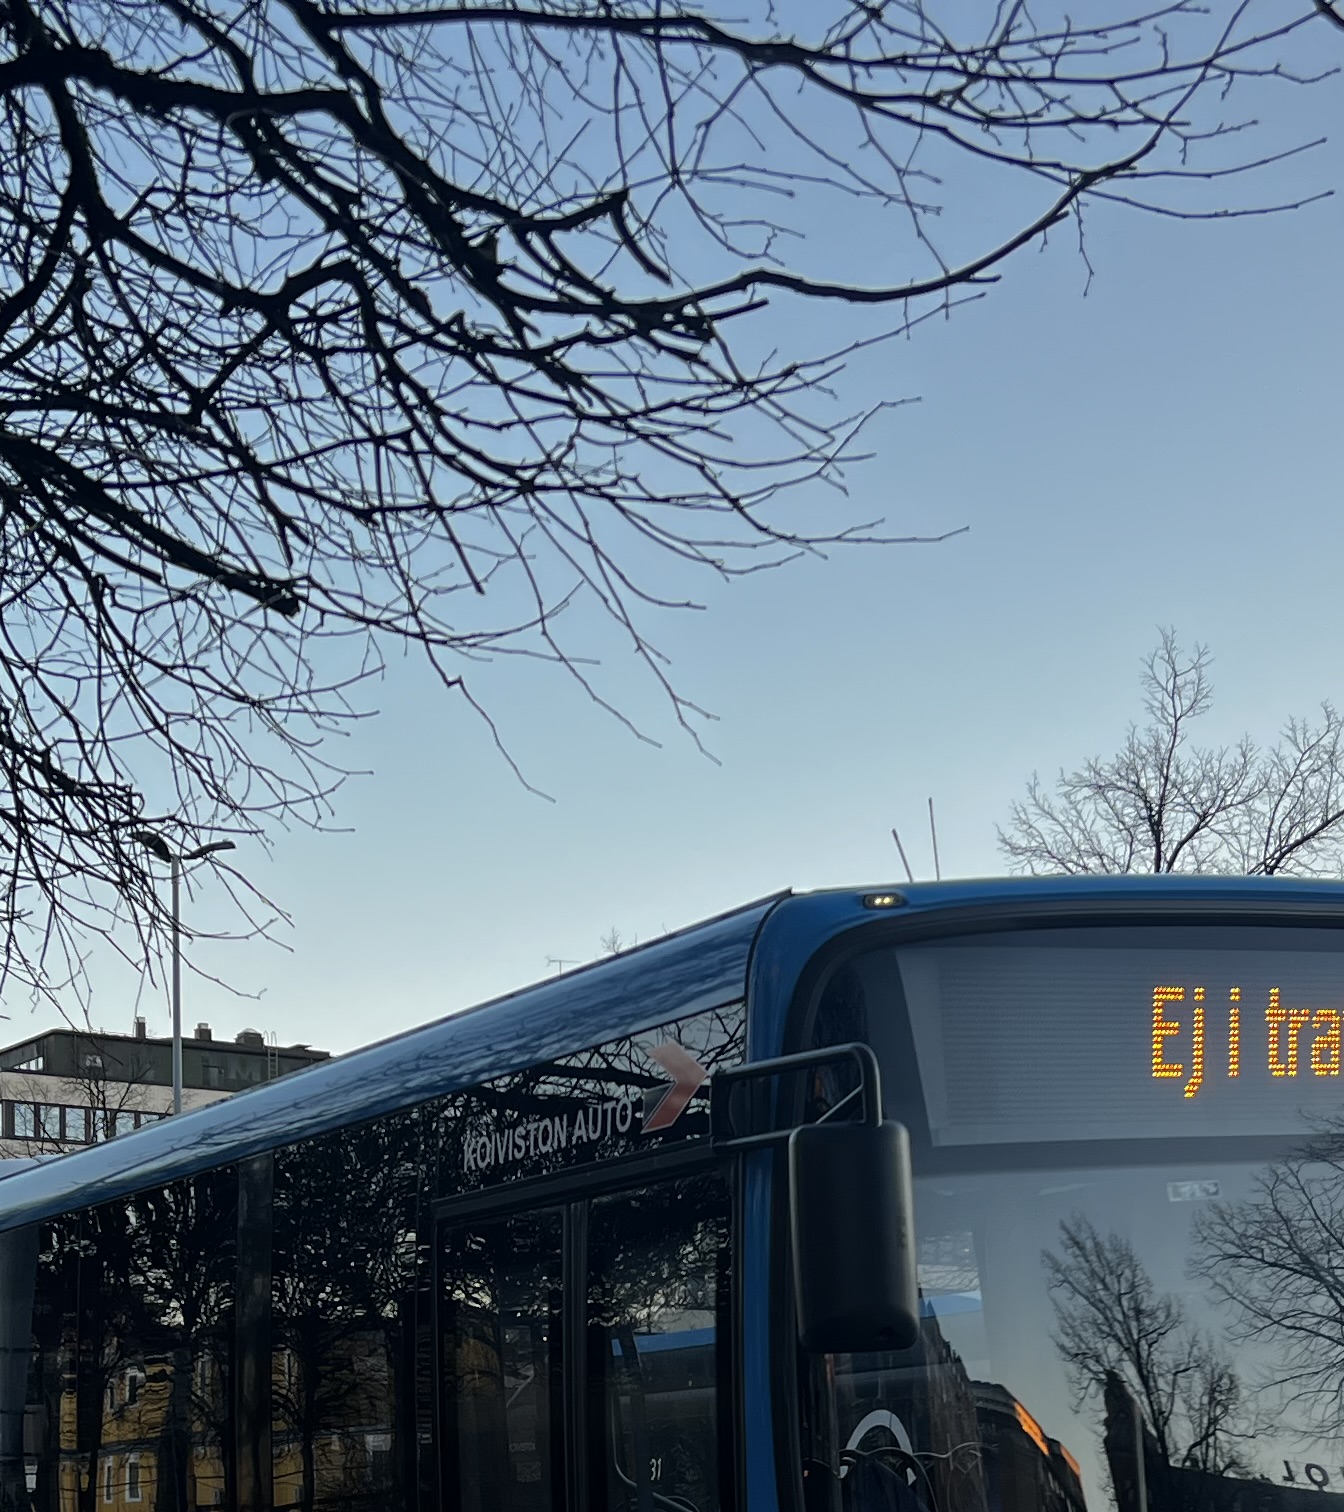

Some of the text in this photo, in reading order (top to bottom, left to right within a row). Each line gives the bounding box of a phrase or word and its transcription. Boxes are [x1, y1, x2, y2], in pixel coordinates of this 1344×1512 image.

[1151, 986, 1207, 1099] Ej
[1227, 986, 1241, 1078] i
[462, 1097, 633, 1173] KOIVISTON AUTO
